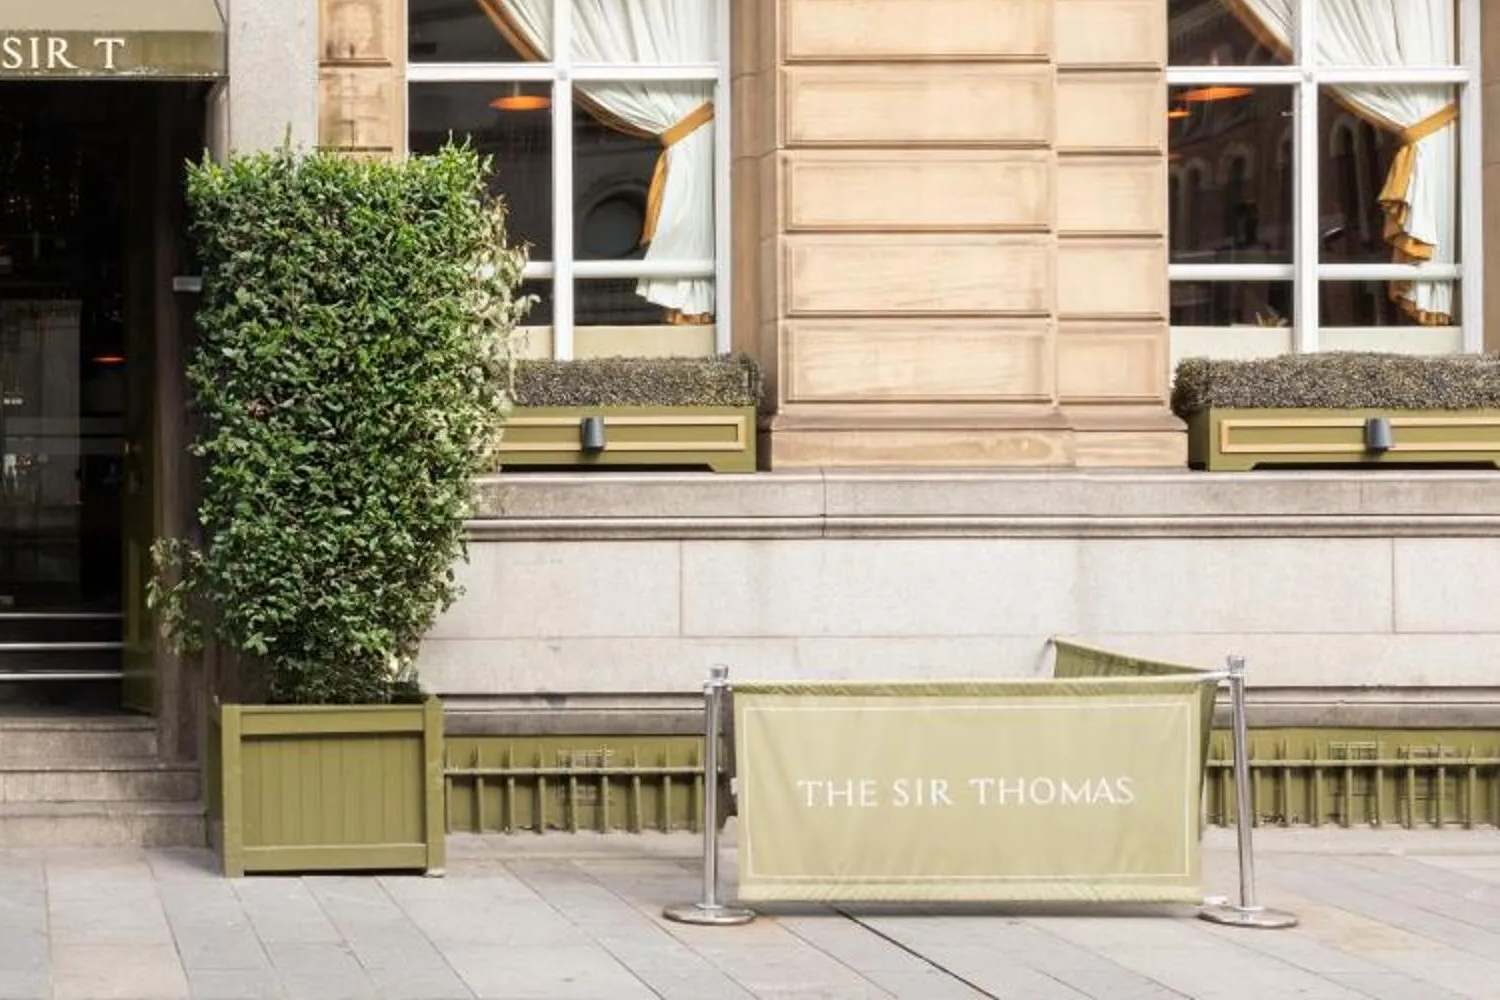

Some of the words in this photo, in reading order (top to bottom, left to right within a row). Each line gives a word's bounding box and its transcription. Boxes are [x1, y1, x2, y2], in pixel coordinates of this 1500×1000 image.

[2, 37, 79, 70] SIR
[94, 38, 126, 70] T
[797, 779, 878, 808] THE
[892, 778, 955, 807] SIR
[968, 776, 1136, 806] THOMAS
